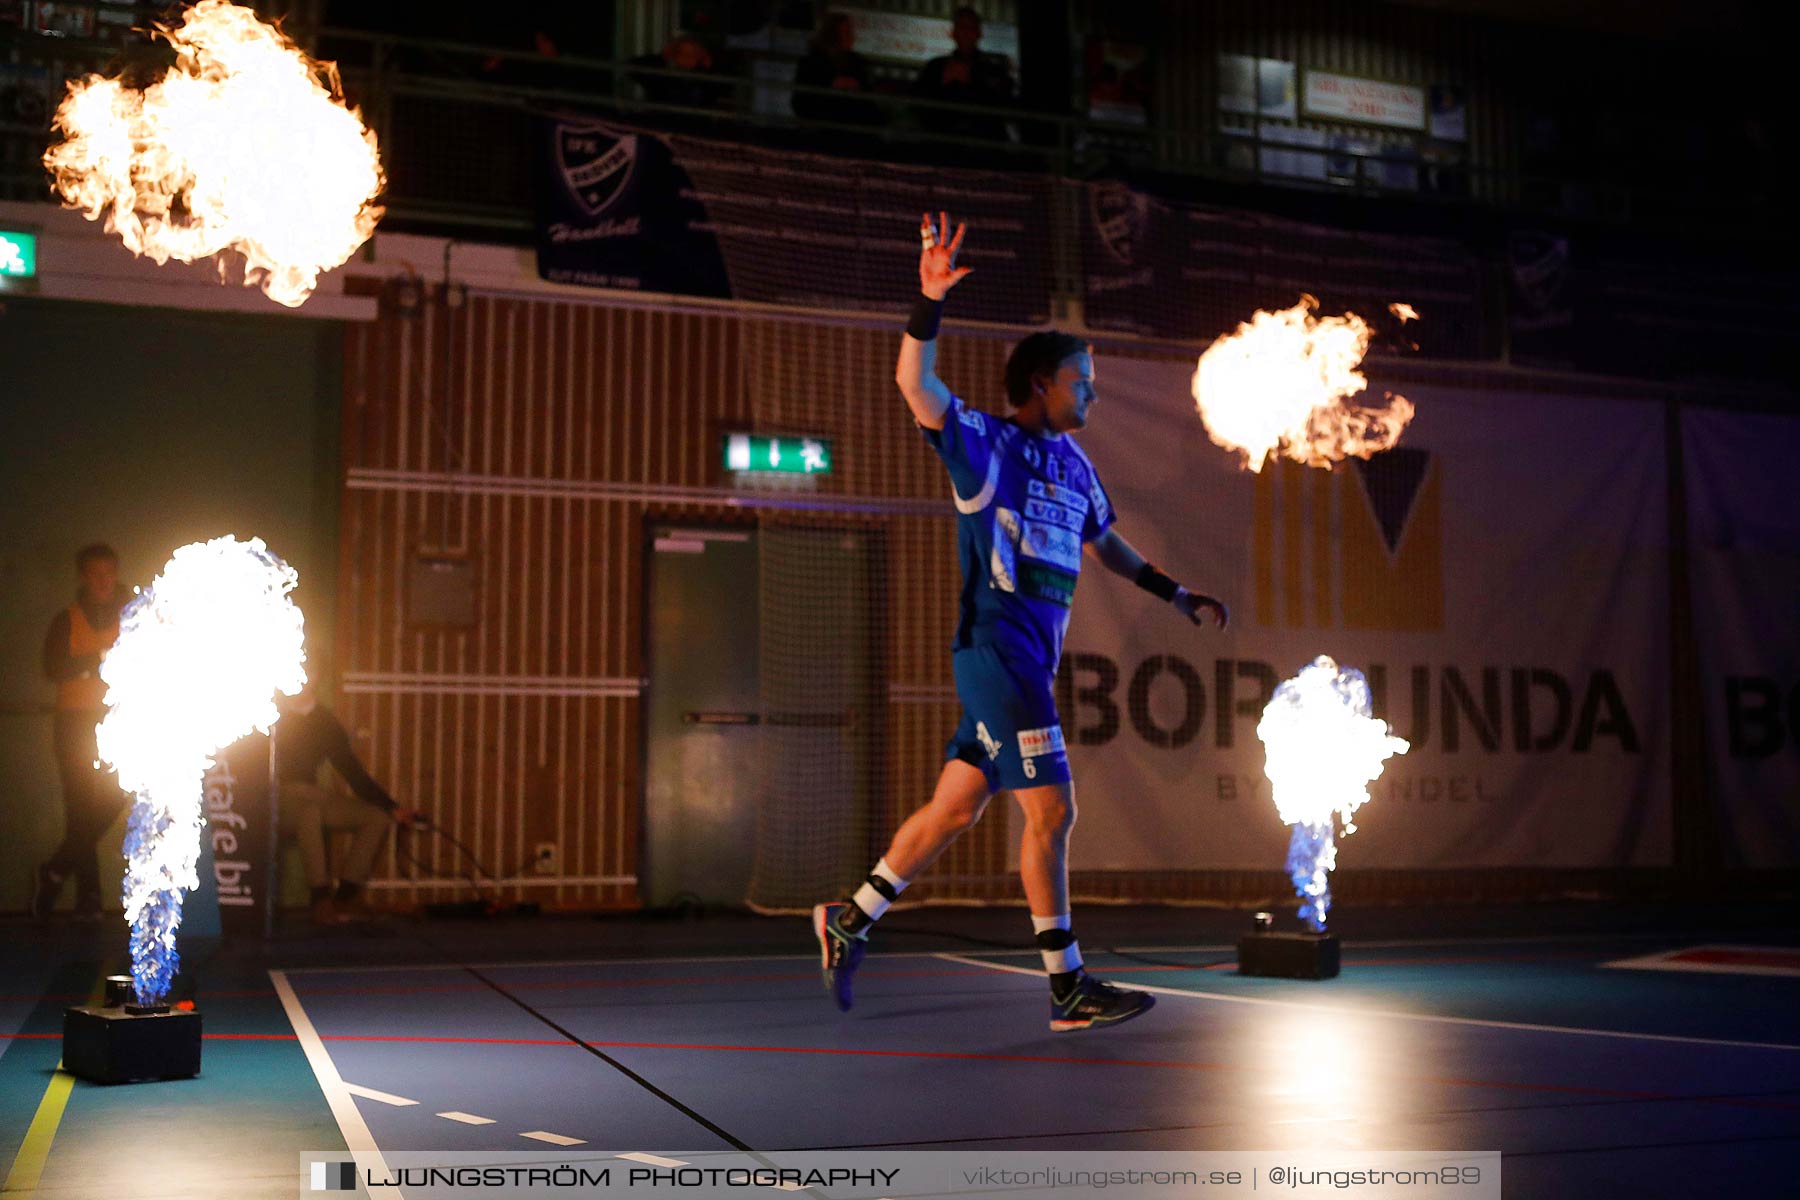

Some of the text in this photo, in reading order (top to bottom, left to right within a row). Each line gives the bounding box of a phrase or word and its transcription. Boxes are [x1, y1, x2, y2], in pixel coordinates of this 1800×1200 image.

[1052, 652, 1641, 753] BORUNDA
[1724, 676, 1800, 758] B
[1022, 758, 1036, 779] 6
